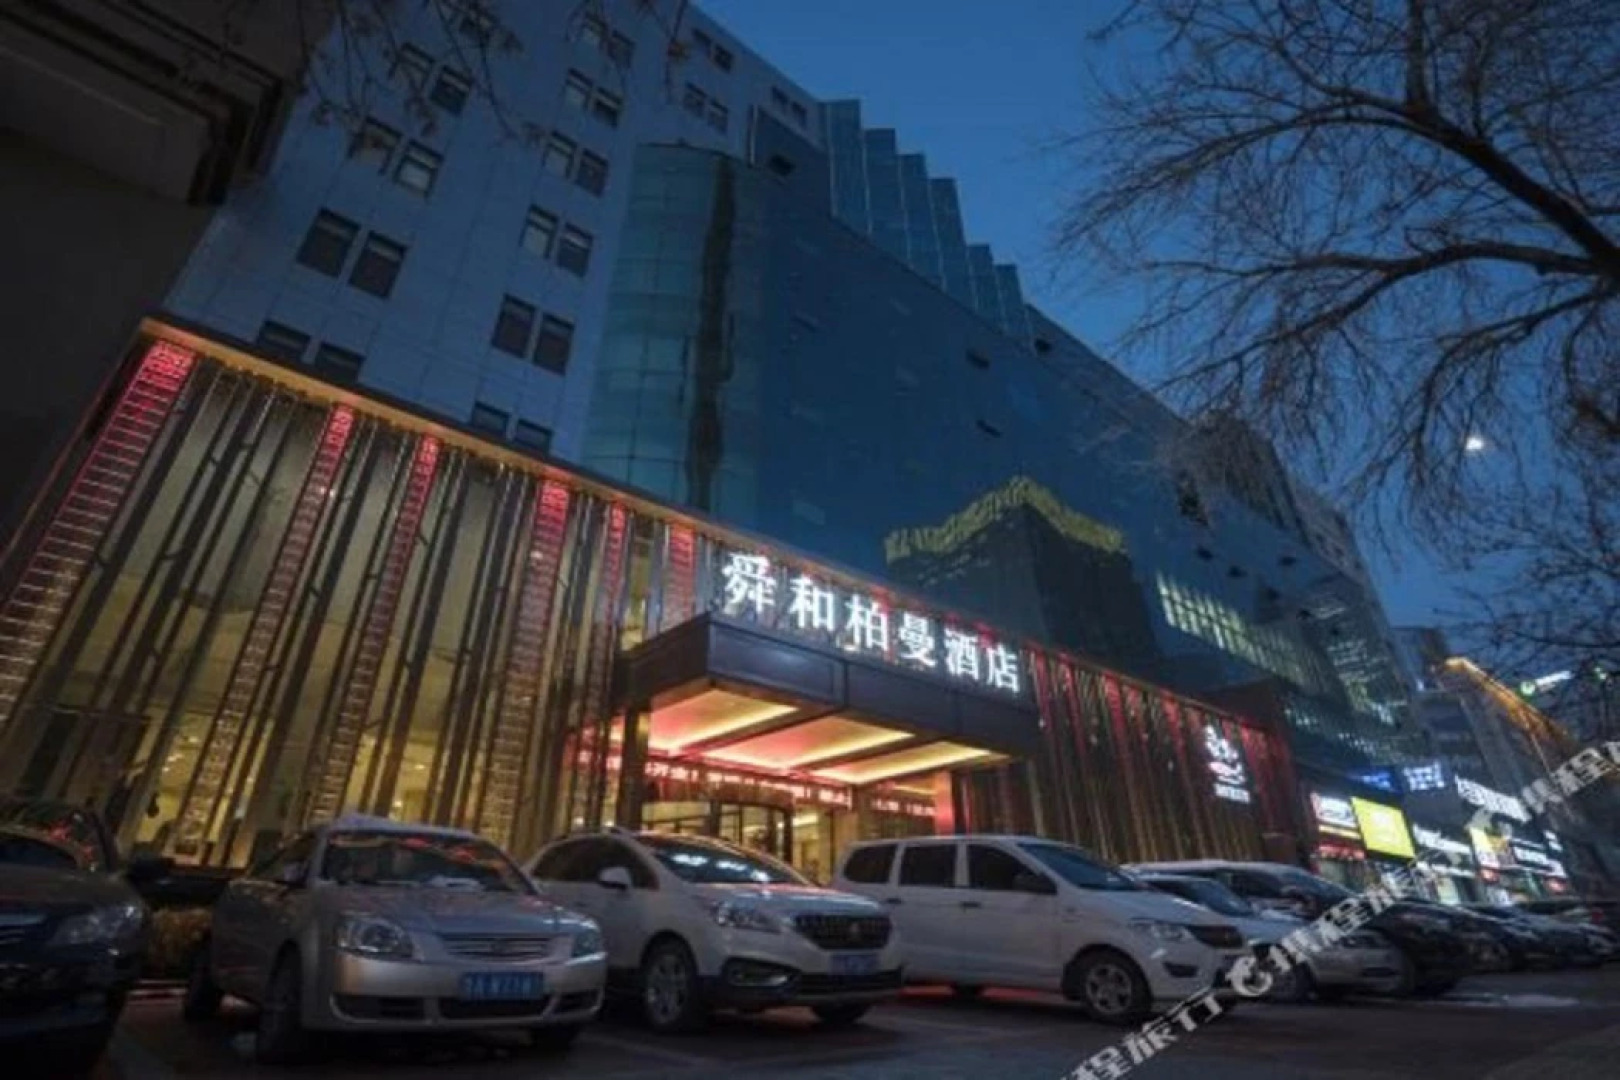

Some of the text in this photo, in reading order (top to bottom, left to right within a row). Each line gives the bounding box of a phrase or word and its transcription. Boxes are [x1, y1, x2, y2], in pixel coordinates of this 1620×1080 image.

[721, 552, 1020, 694] 舜和柏曼酒店
